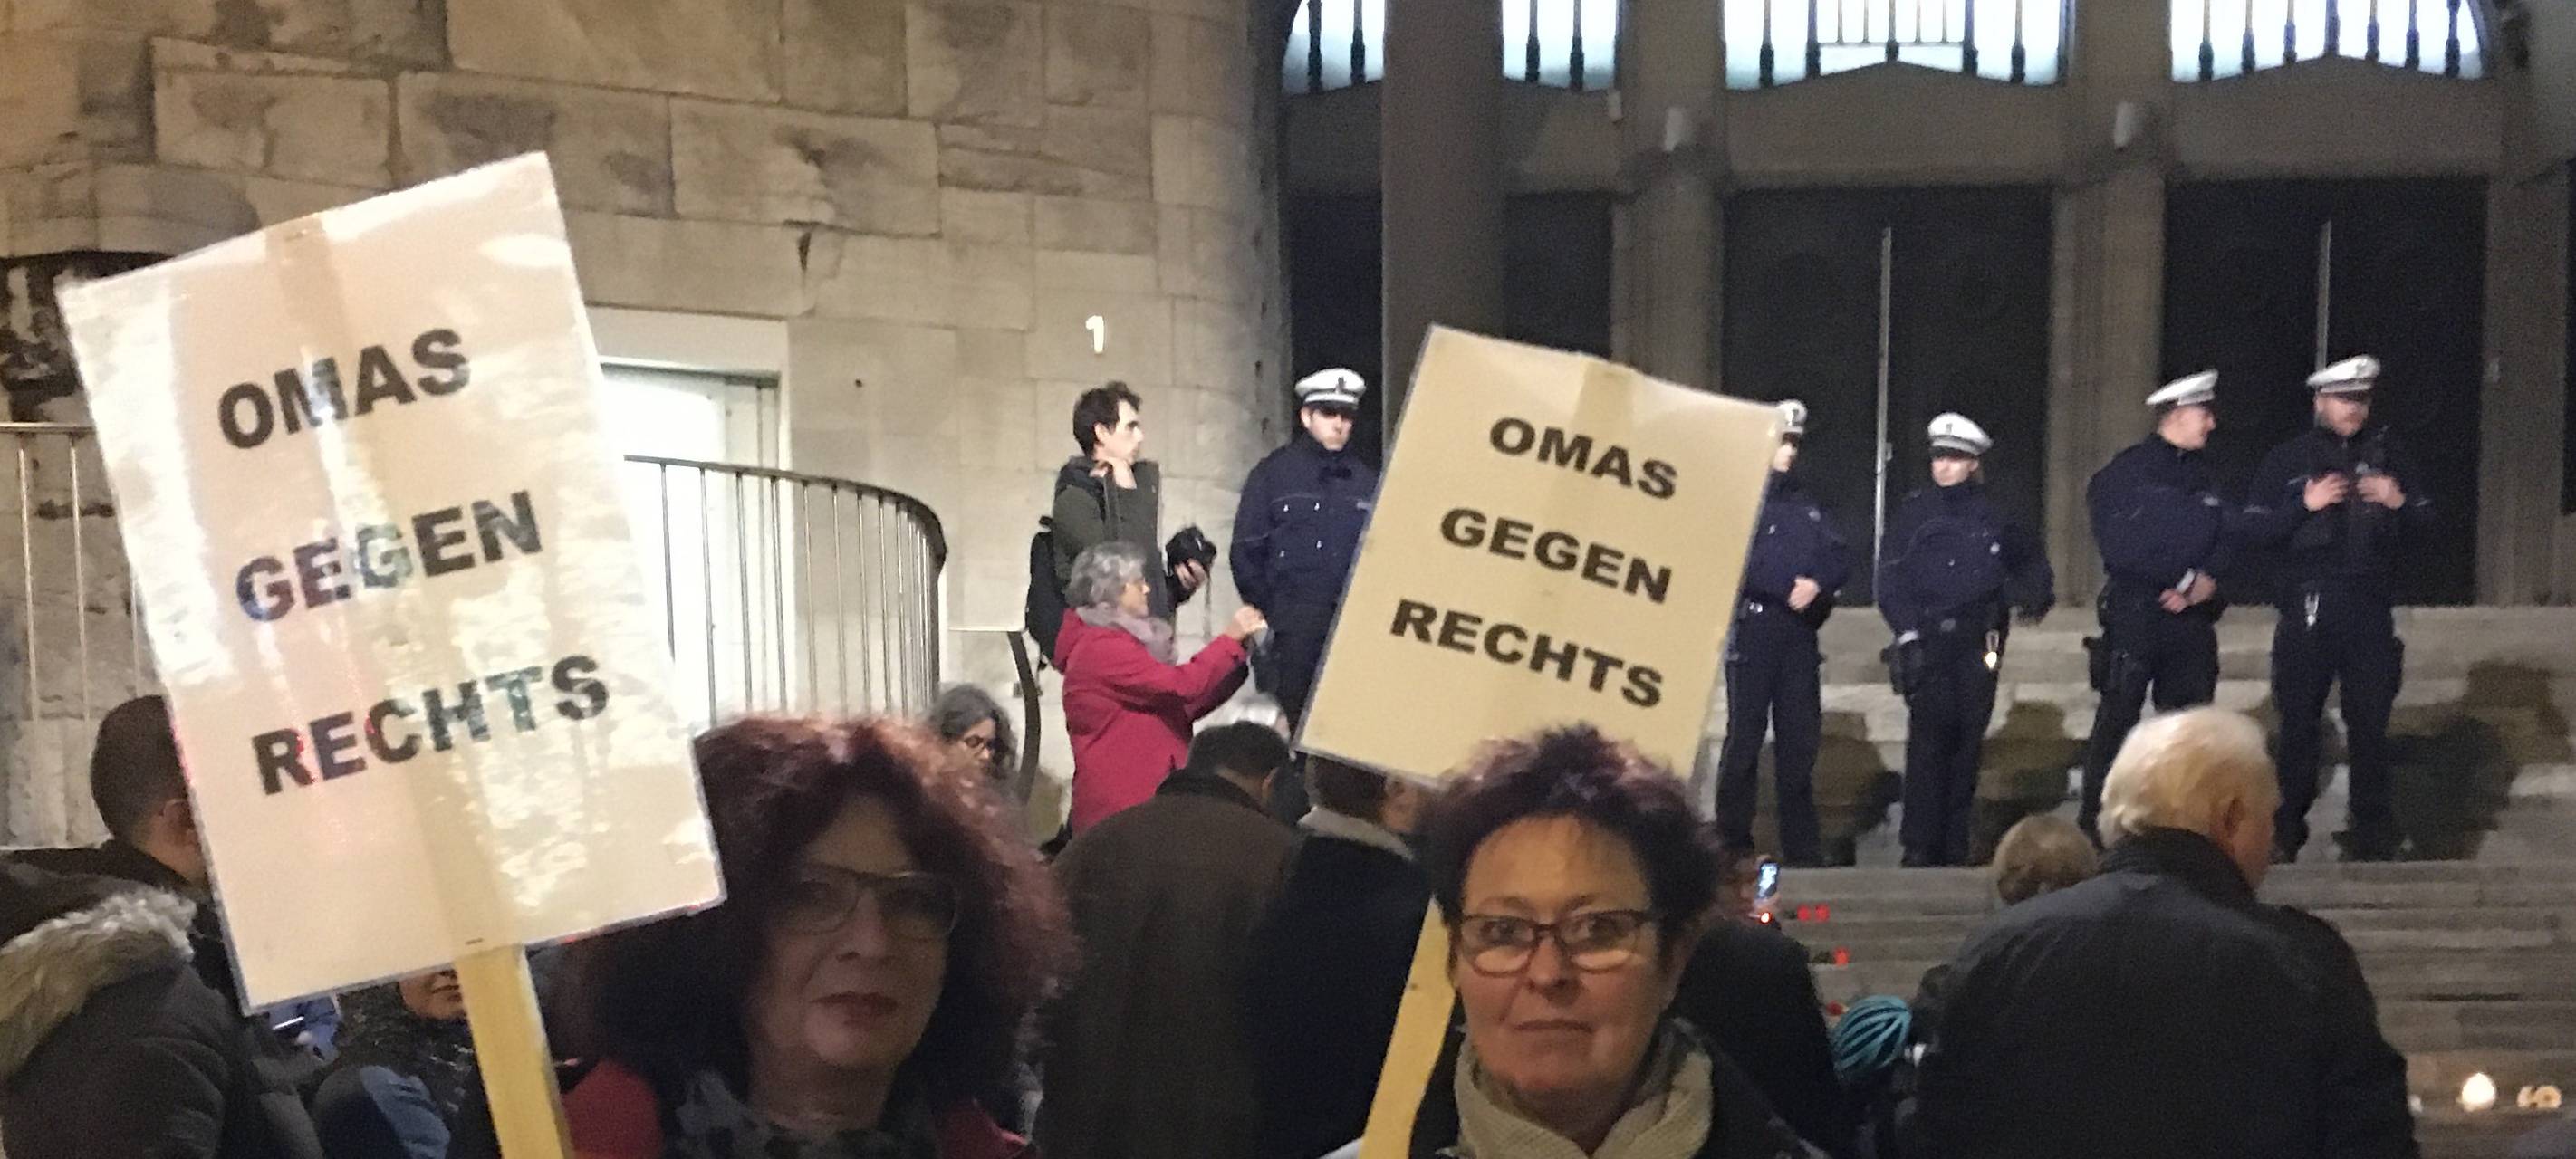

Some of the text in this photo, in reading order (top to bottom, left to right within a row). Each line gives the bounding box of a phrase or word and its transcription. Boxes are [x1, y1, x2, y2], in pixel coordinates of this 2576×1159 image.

[217, 328, 472, 450] OMAS
[1085, 314, 1106, 354] 1
[1489, 417, 1678, 500] OMAS
[235, 490, 543, 623] GEGEN
[1440, 507, 1673, 605] GEGEN
[1389, 598, 1664, 709] RECHTS
[252, 655, 610, 796] RECHTS
